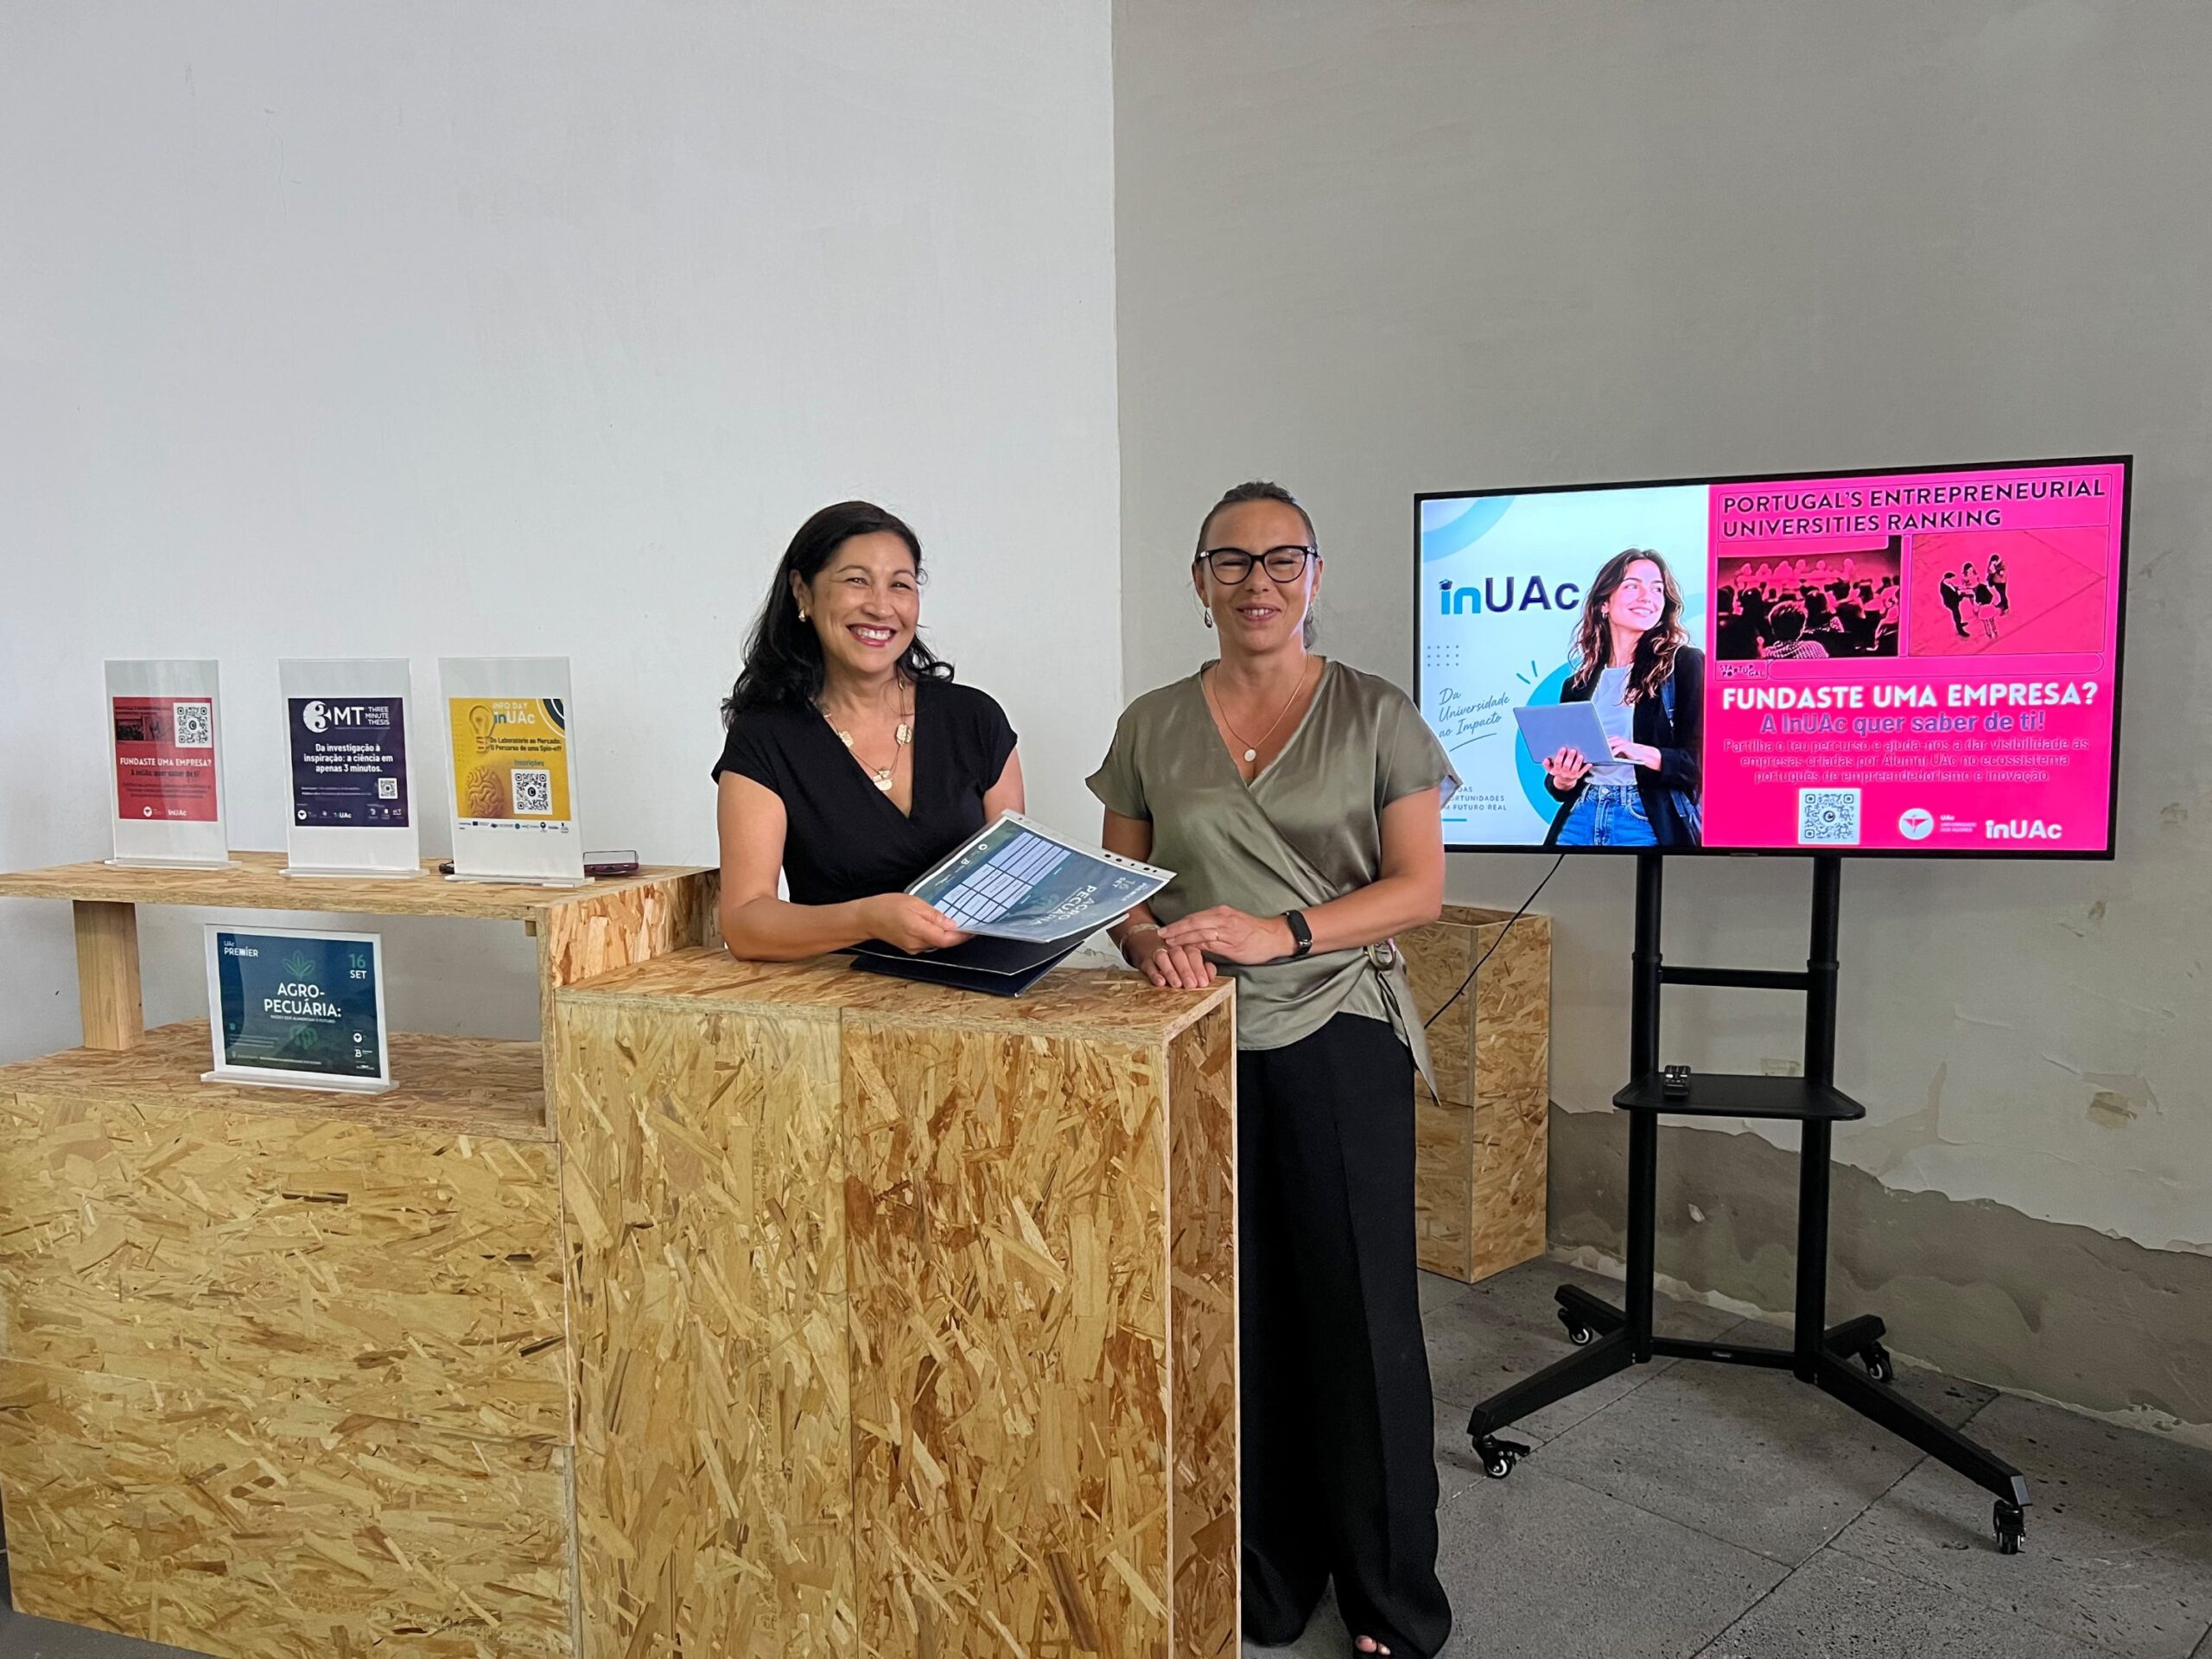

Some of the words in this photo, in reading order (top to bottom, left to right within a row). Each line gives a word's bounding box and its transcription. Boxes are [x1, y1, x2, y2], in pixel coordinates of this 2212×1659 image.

[1871, 479, 2106, 506] ENTREPRENEURIAL
[1724, 515, 1879, 537] UNIVERSITIES
[1888, 509, 2001, 531] RANKING
[1439, 575, 1580, 614] inUAc
[1439, 688, 1461, 706] Da
[1723, 686, 1864, 710] FUNDASTE
[1872, 683, 1937, 709] UMA
[1948, 681, 2098, 707] EMPRESA?
[1439, 692, 1510, 722] Universidade
[1439, 729, 1452, 739] ao
[1455, 712, 1503, 735] Impacto
[1761, 715, 1777, 734] A
[1783, 714, 1847, 733] InUAc
[1853, 717, 1905, 736] quer
[1911, 712, 1978, 732] saber
[1985, 711, 2013, 731] de
[2020, 710, 2045, 731] ti!
[315, 743, 326, 752] Da
[327, 743, 375, 754] investigação
[1724, 740, 1772, 752] Partilha
[1777, 742, 1783, 751] o
[1789, 741, 1808, 751] teu
[1812, 741, 1868, 753] percurso
[1872, 741, 1880, 750] e
[1885, 739, 1949, 753] ajuda-nos
[1954, 741, 1961, 750] a
[1966, 739, 1986, 750] dar
[1992, 737, 2069, 750] visibilidade
[119, 758, 156, 767] FUNDASTE
[157, 758, 174, 767] UMA
[175, 759, 213, 768] EMPRESA?
[315, 766, 343, 774] apenas
[350, 764, 383, 772] minutos.
[1741, 757, 1802, 768] empresas
[1807, 754, 1853, 766] criadas
[1858, 756, 1878, 768] por
[1882, 753, 1927, 766] Alumni
[1931, 753, 1957, 766] UAc
[1961, 756, 1978, 766] no
[1982, 754, 2069, 766] ecossistema
[1823, 770, 1839, 781] de
[1842, 770, 1970, 784] empreendedorismo
[1975, 772, 1982, 781] e
[1986, 820, 2063, 840] inUAc
[349, 953, 366, 969] 16
[350, 969, 366, 979] SET
[277, 982, 325, 998] AGRO-
[264, 997, 341, 1018] PECUÁRIA:
